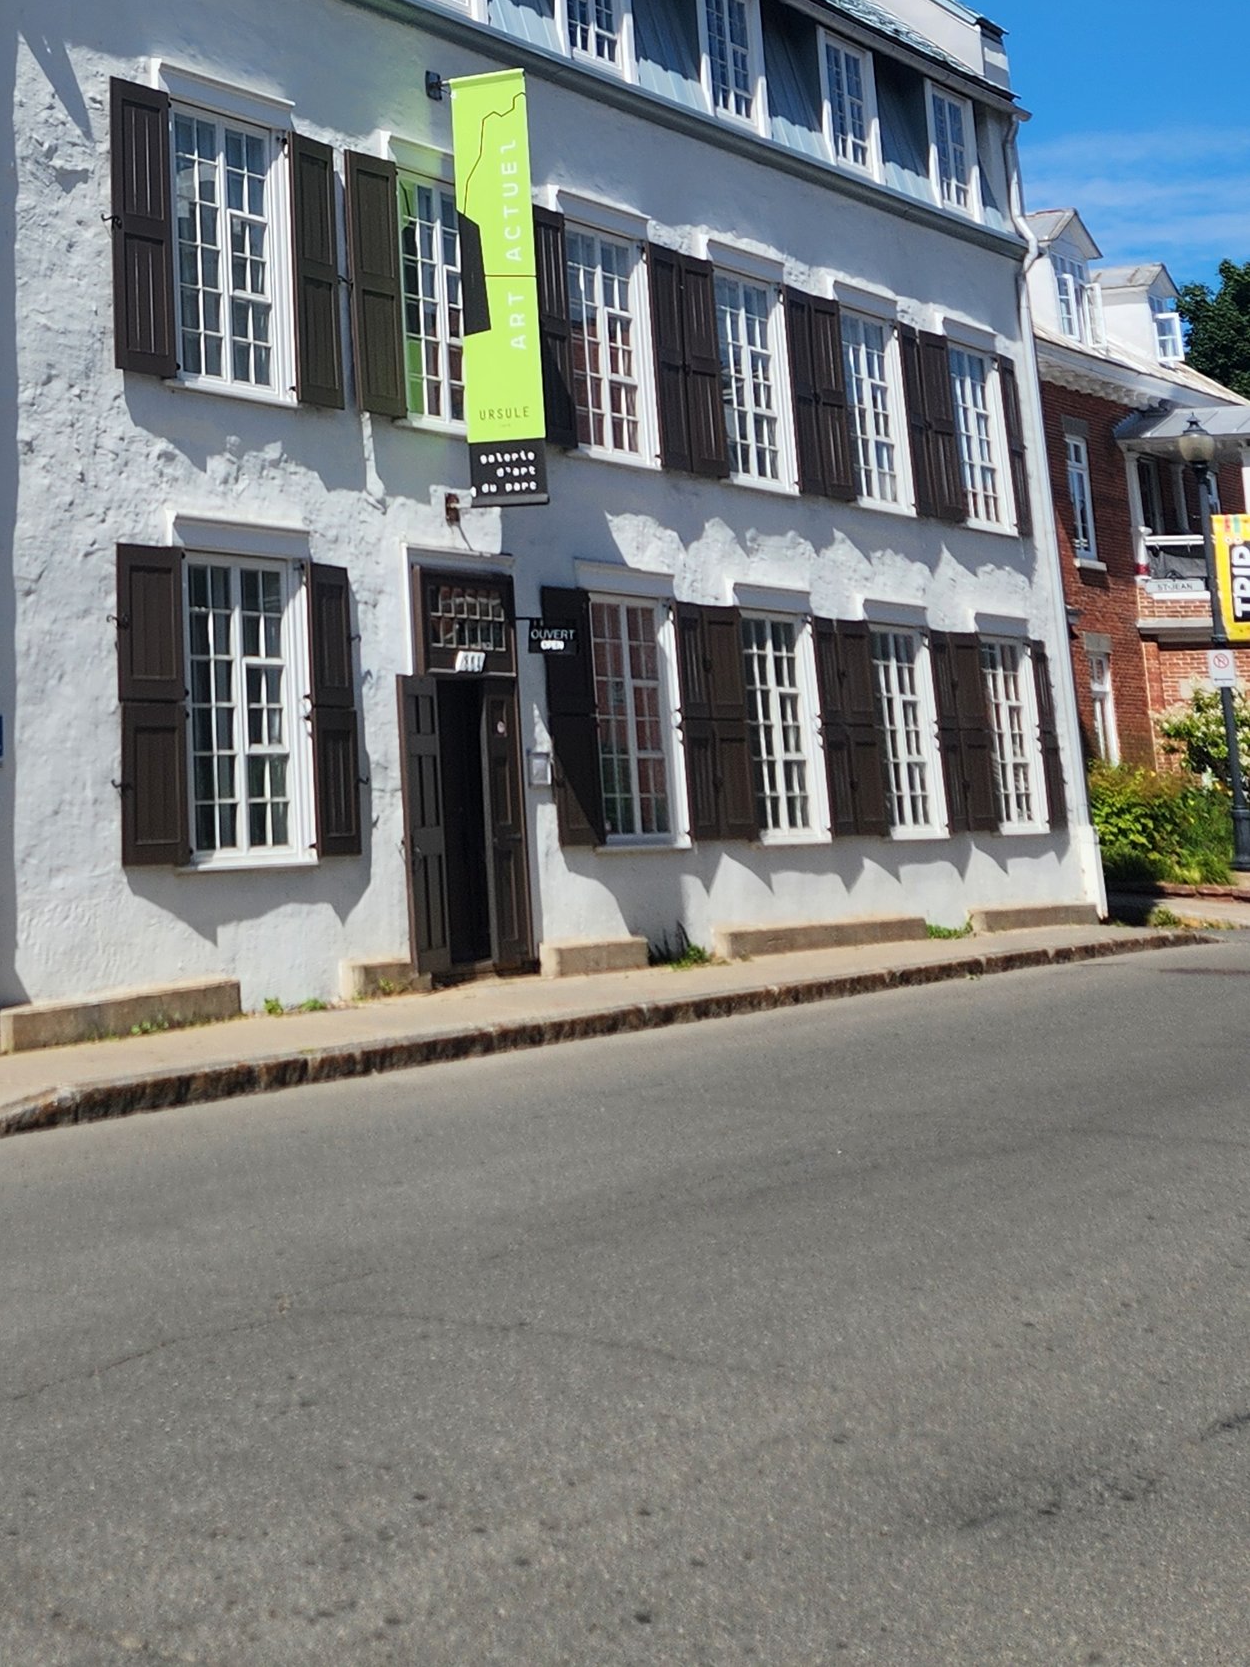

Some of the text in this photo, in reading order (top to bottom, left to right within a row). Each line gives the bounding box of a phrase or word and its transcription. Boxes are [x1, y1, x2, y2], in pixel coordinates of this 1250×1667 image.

[500, 139, 527, 351] ART ACTUEL
[479, 406, 530, 420] URSULE
[481, 482, 497, 494] du
[530, 628, 576, 641] OUVERT
[540, 639, 565, 651] OPEN
